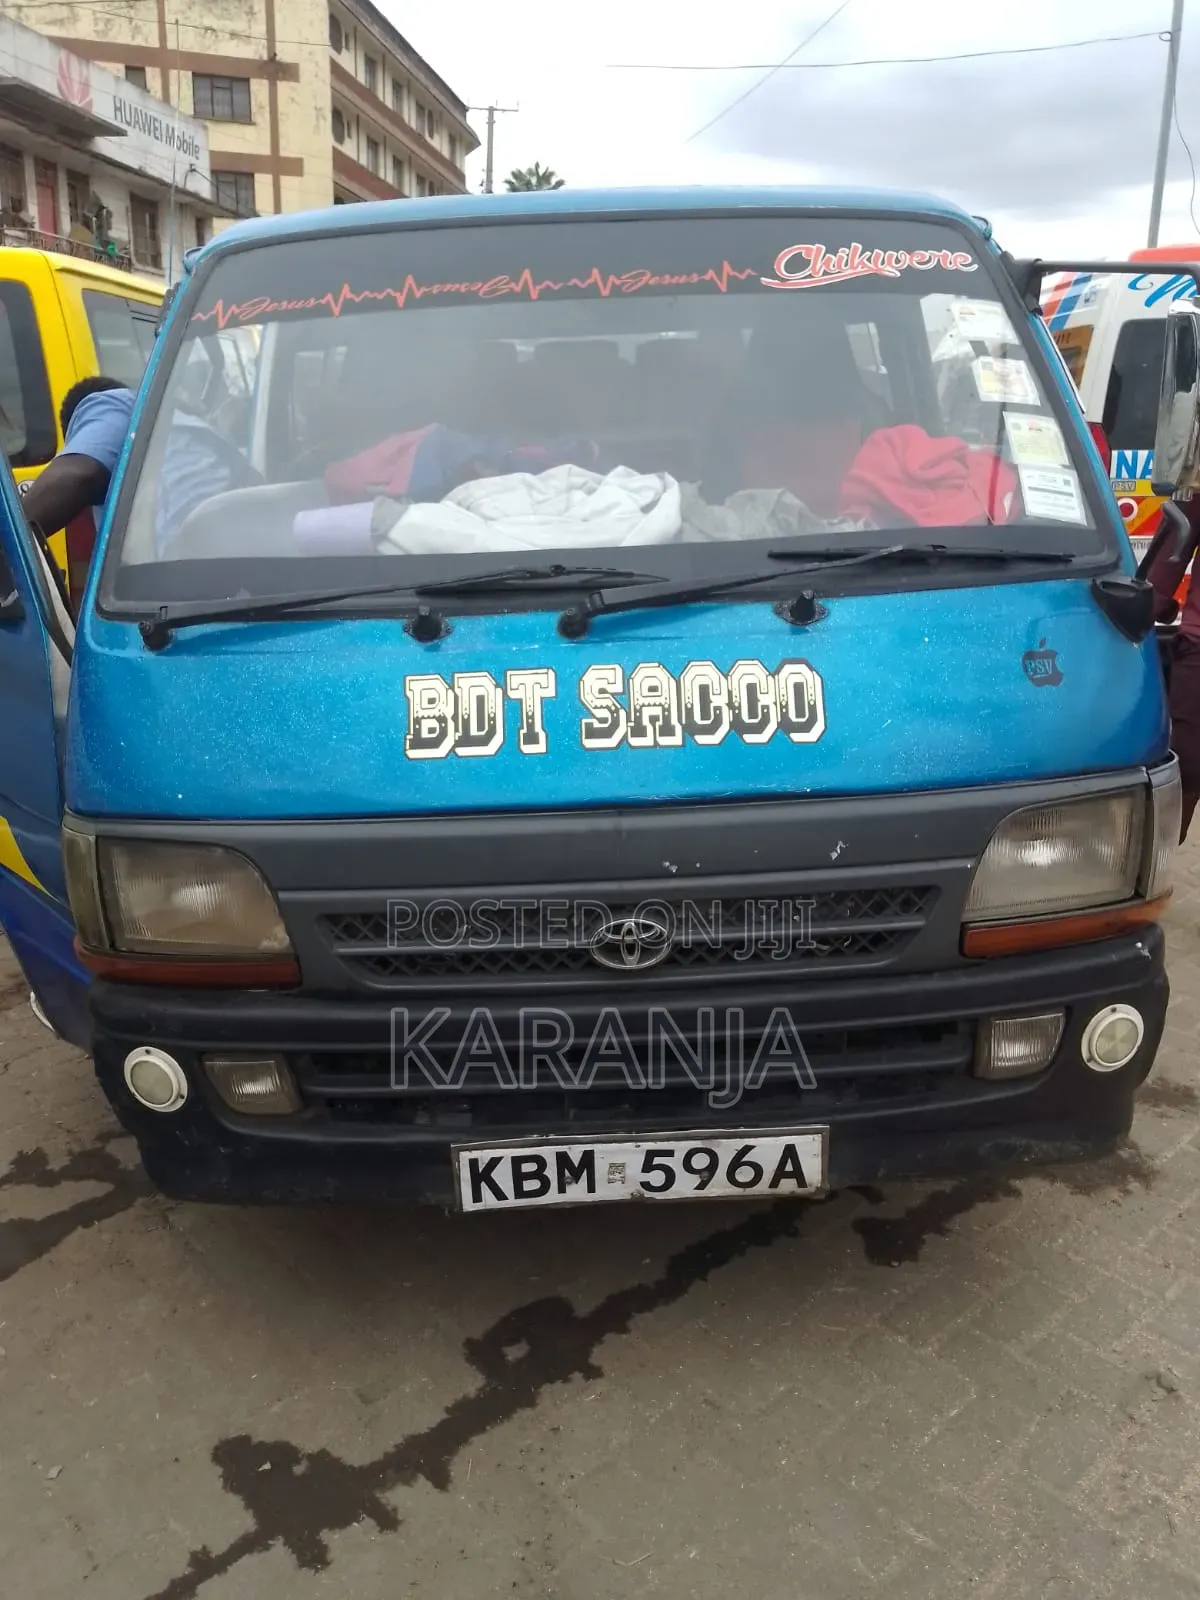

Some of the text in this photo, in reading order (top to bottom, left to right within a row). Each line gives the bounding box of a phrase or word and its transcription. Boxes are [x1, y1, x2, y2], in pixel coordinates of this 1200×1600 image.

[113, 95, 200, 160] HUAWEI Mobile
[619, 269, 700, 293] Jesus
[764, 242, 978, 286] Chikwere
[404, 658, 828, 760] BDT SACCO
[468, 1149, 596, 1204] KBM
[639, 1143, 809, 1193] 596A
